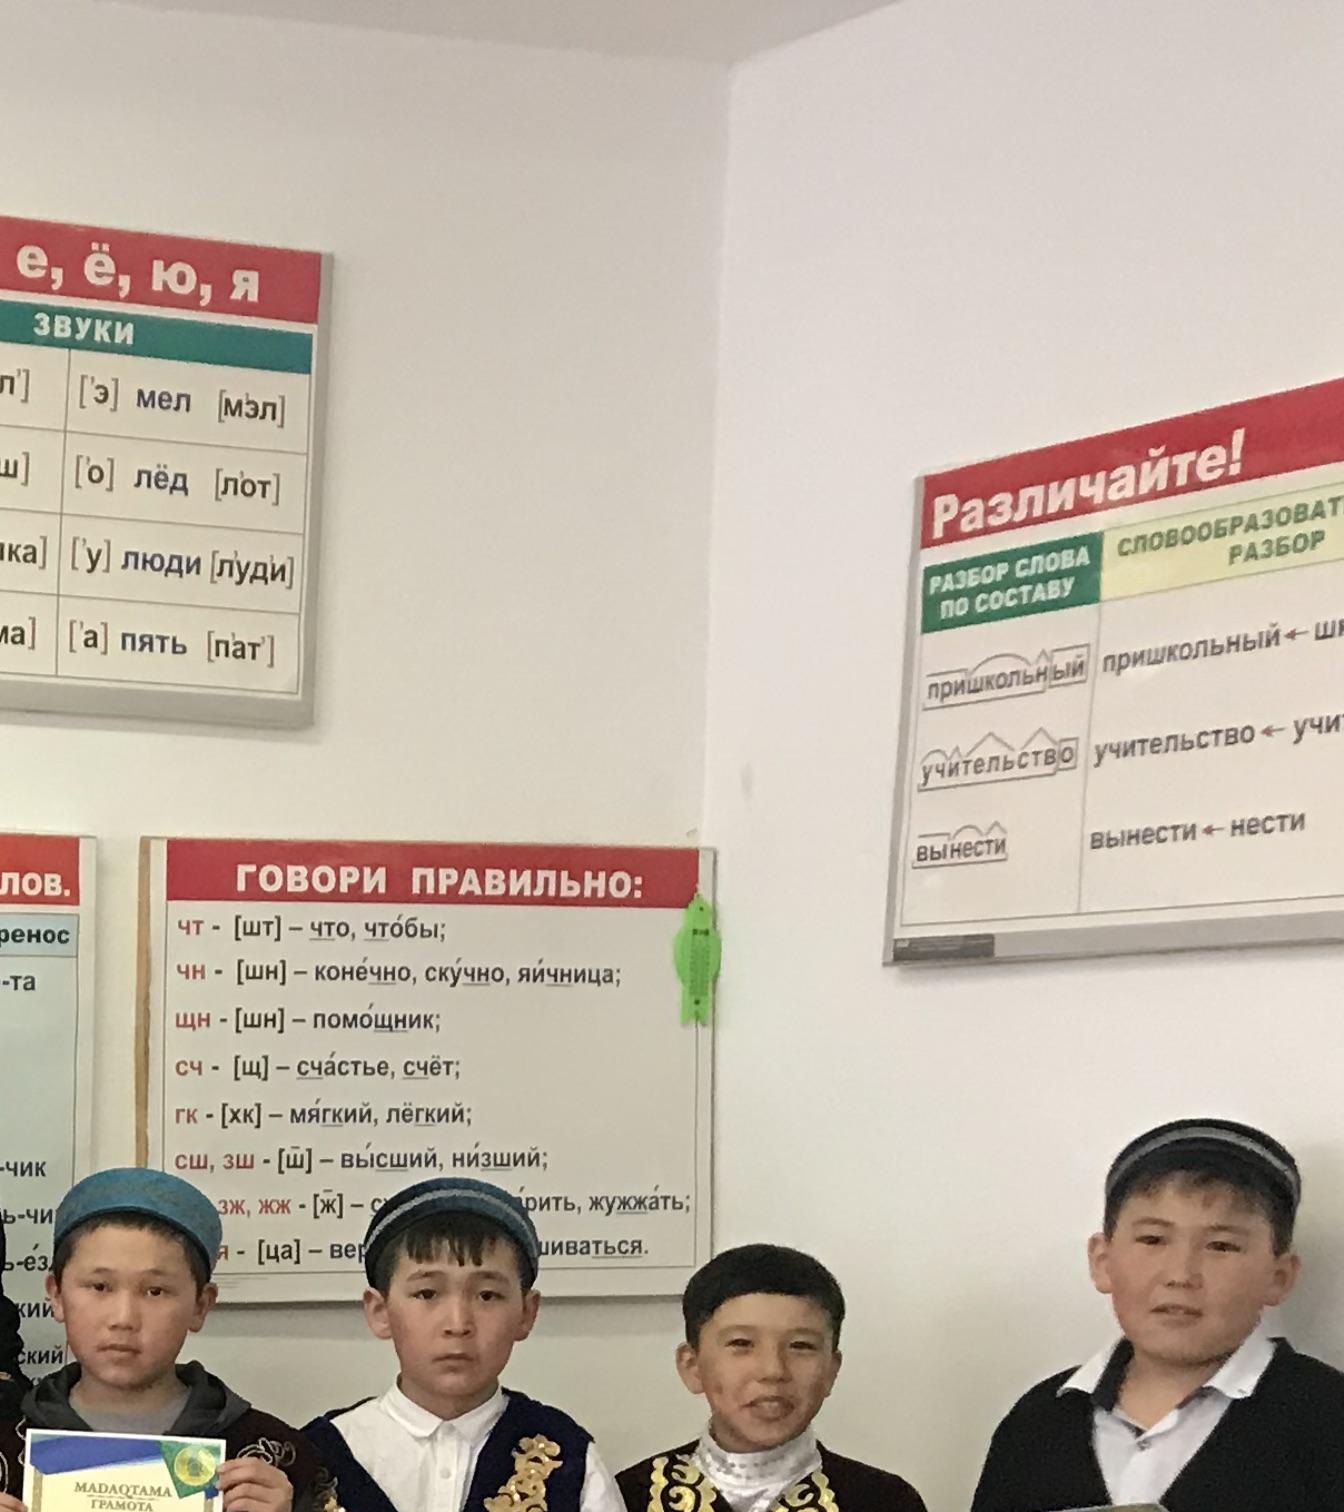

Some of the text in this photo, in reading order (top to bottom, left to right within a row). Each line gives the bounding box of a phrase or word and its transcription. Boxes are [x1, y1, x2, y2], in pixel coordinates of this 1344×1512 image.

[16, 244, 64, 291] е,
[83, 241, 132, 299] ё,
[151, 258, 213, 307] ю,
[229, 268, 260, 303] я
[32, 312, 135, 345] ЗВУКИ
[135, 388, 192, 413] мел
[133, 463, 189, 497] лёд
[932, 427, 1246, 540] Различайте!
[1117, 494, 1344, 557] СЛОВООБРАЗОВАТ
[1228, 530, 1326, 565] РАЗБОР
[120, 550, 202, 579] люди
[929, 546, 1091, 595] РАЗБОР СЛОВА
[940, 577, 1076, 620] ПО СОСТАВУ
[120, 632, 188, 655] пять
[1102, 622, 1281, 677] пришкольный
[928, 655, 1087, 704] пришкольный
[1093, 724, 1256, 769] учительство
[921, 745, 1075, 787] учительство
[1090, 812, 1306, 850] вынести нести
[916, 837, 1008, 863] вынести
[235, 864, 644, 899] ГОВОРИ ПРАВИЛЬНО:
[177, 919, 204, 936] чт
[234, 915, 282, 942] [шт]
[310, 920, 356, 941] что,
[176, 964, 206, 980] чн
[236, 959, 287, 986] [шн]
[175, 1012, 211, 1031] щн
[234, 1007, 285, 1034] [шн]
[175, 1059, 203, 1077] сч
[234, 1055, 269, 1081] [щ]
[403, 1054, 461, 1079] счёт;
[175, 1107, 198, 1124] гк
[221, 1102, 262, 1129] [хк]
[386, 1102, 472, 1127] лёгкий;
[175, 1153, 215, 1173] сш,
[222, 1153, 255, 1170] зш
[218, 1199, 251, 1217] зж,
[258, 1199, 292, 1215] жж
[258, 1239, 301, 1266] [ца]
[73, 1481, 173, 1499] MADAQTAMA
[90, 1498, 154, 1512] ГРАМОТА
